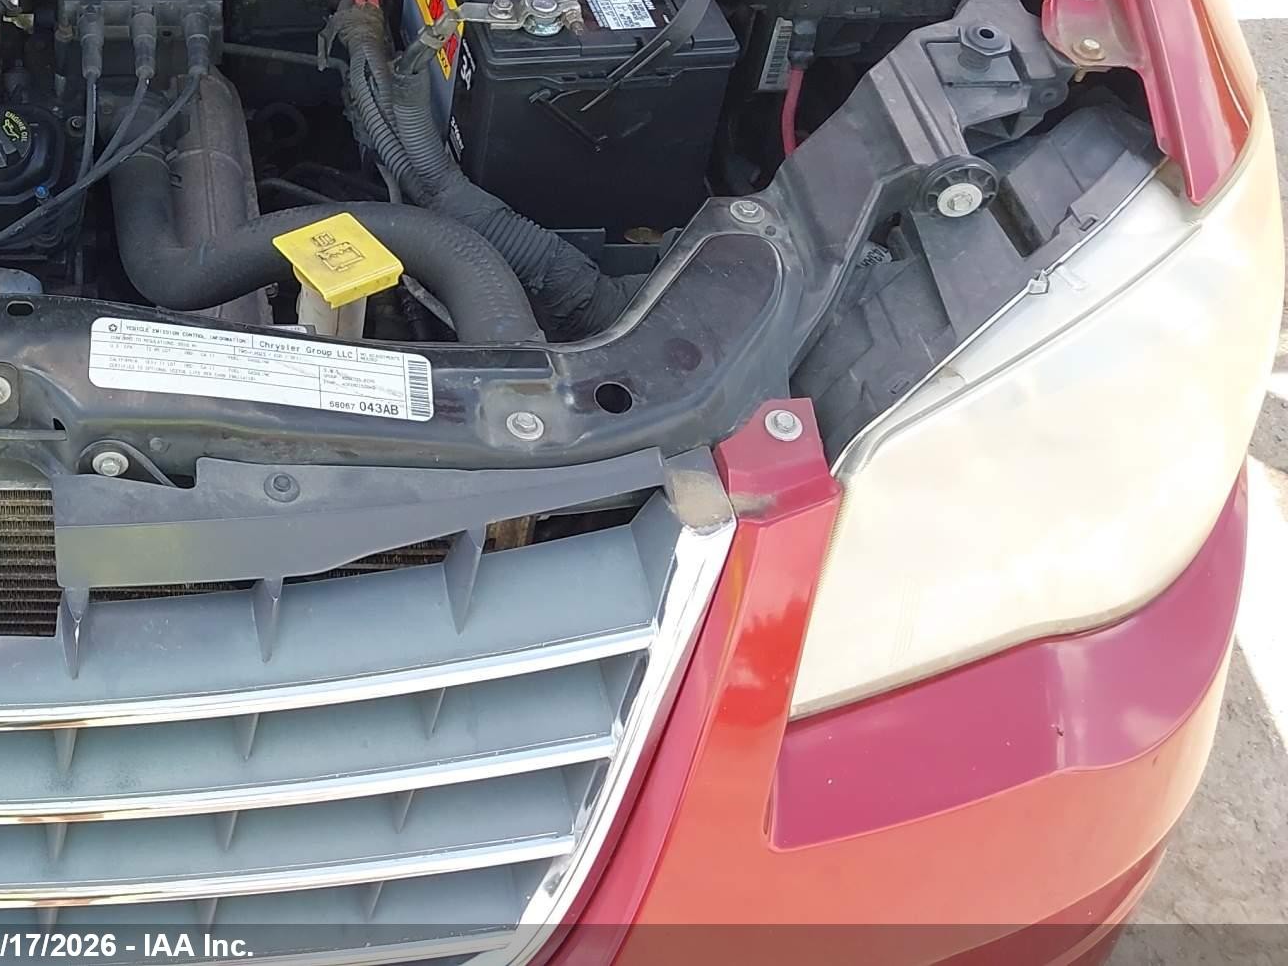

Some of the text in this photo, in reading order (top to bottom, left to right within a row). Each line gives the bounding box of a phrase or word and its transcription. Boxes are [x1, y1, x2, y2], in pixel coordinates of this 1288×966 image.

[4, 111, 28, 142] ENGINE OIL
[152, 328, 180, 336] EMISSION
[182, 331, 206, 339] CONTROL
[209, 335, 246, 343] INFORMATION
[260, 340, 300, 352] Chrysler
[306, 346, 333, 358] Group
[337, 350, 353, 358] LLC
[359, 401, 399, 415] 043AB
